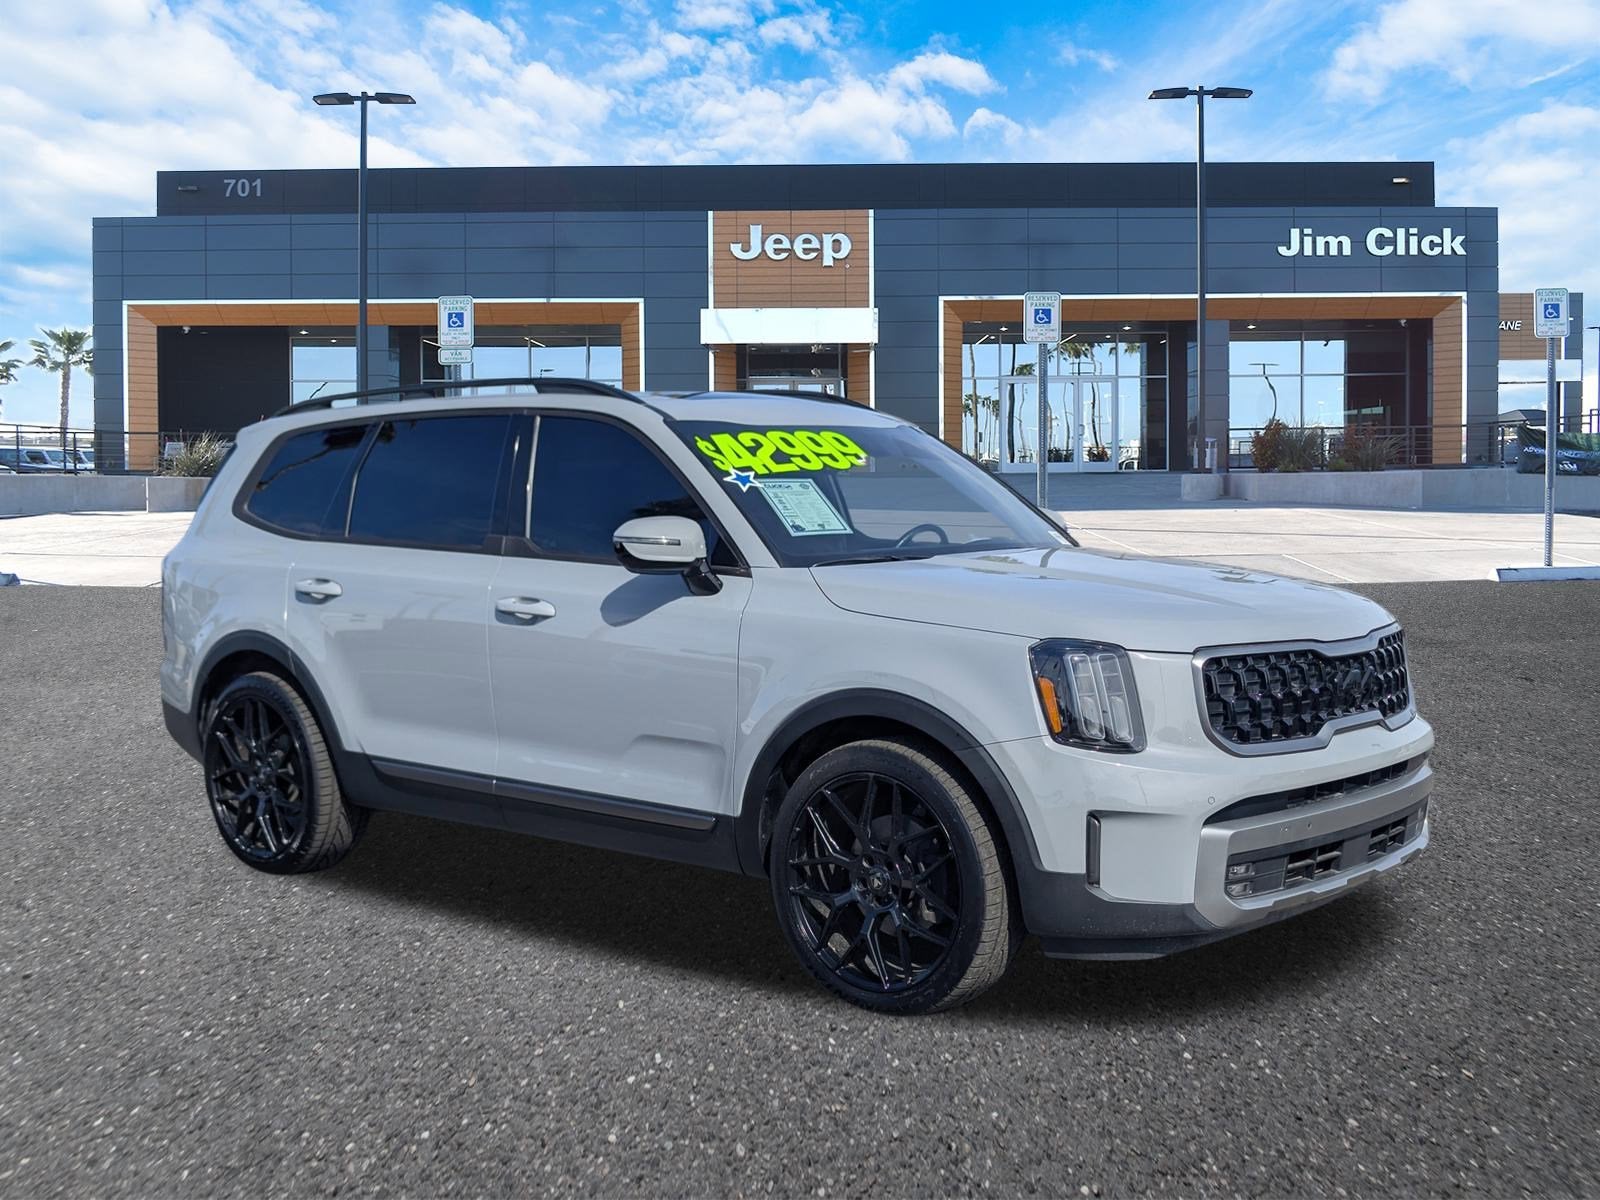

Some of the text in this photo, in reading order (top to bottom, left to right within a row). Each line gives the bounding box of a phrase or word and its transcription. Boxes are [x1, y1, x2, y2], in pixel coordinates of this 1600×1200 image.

[223, 178, 262, 198] 701
[729, 223, 853, 268] Jeep
[1277, 226, 1468, 257] Jim Click
[693, 430, 868, 475] $42999
